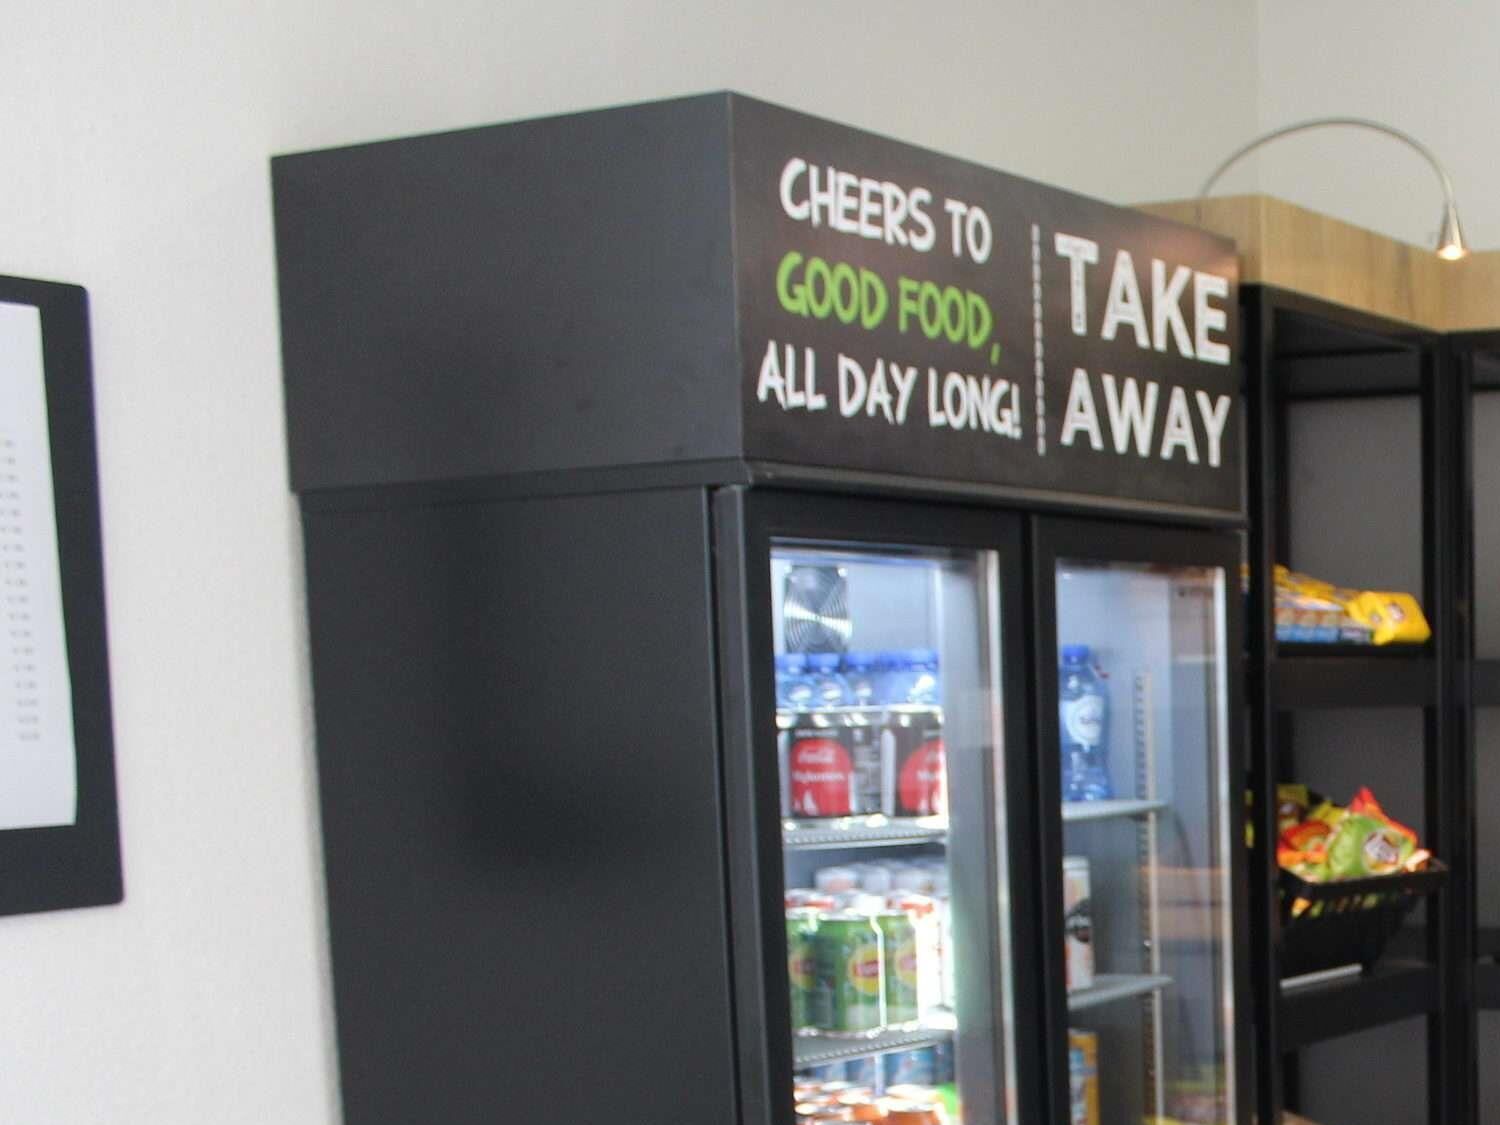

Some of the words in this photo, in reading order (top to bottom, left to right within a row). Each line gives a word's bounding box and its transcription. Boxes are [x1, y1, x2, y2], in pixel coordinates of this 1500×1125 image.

[779, 157, 936, 252] CHEERS
[944, 197, 993, 264] TO
[776, 250, 890, 328] GOOD
[898, 277, 1001, 364] FOOD,
[1054, 232, 1231, 365] TAKE
[757, 340, 827, 410] ALL
[837, 354, 918, 424] DAY
[928, 367, 1022, 439] LONG!
[1060, 367, 1231, 467] AWAY
